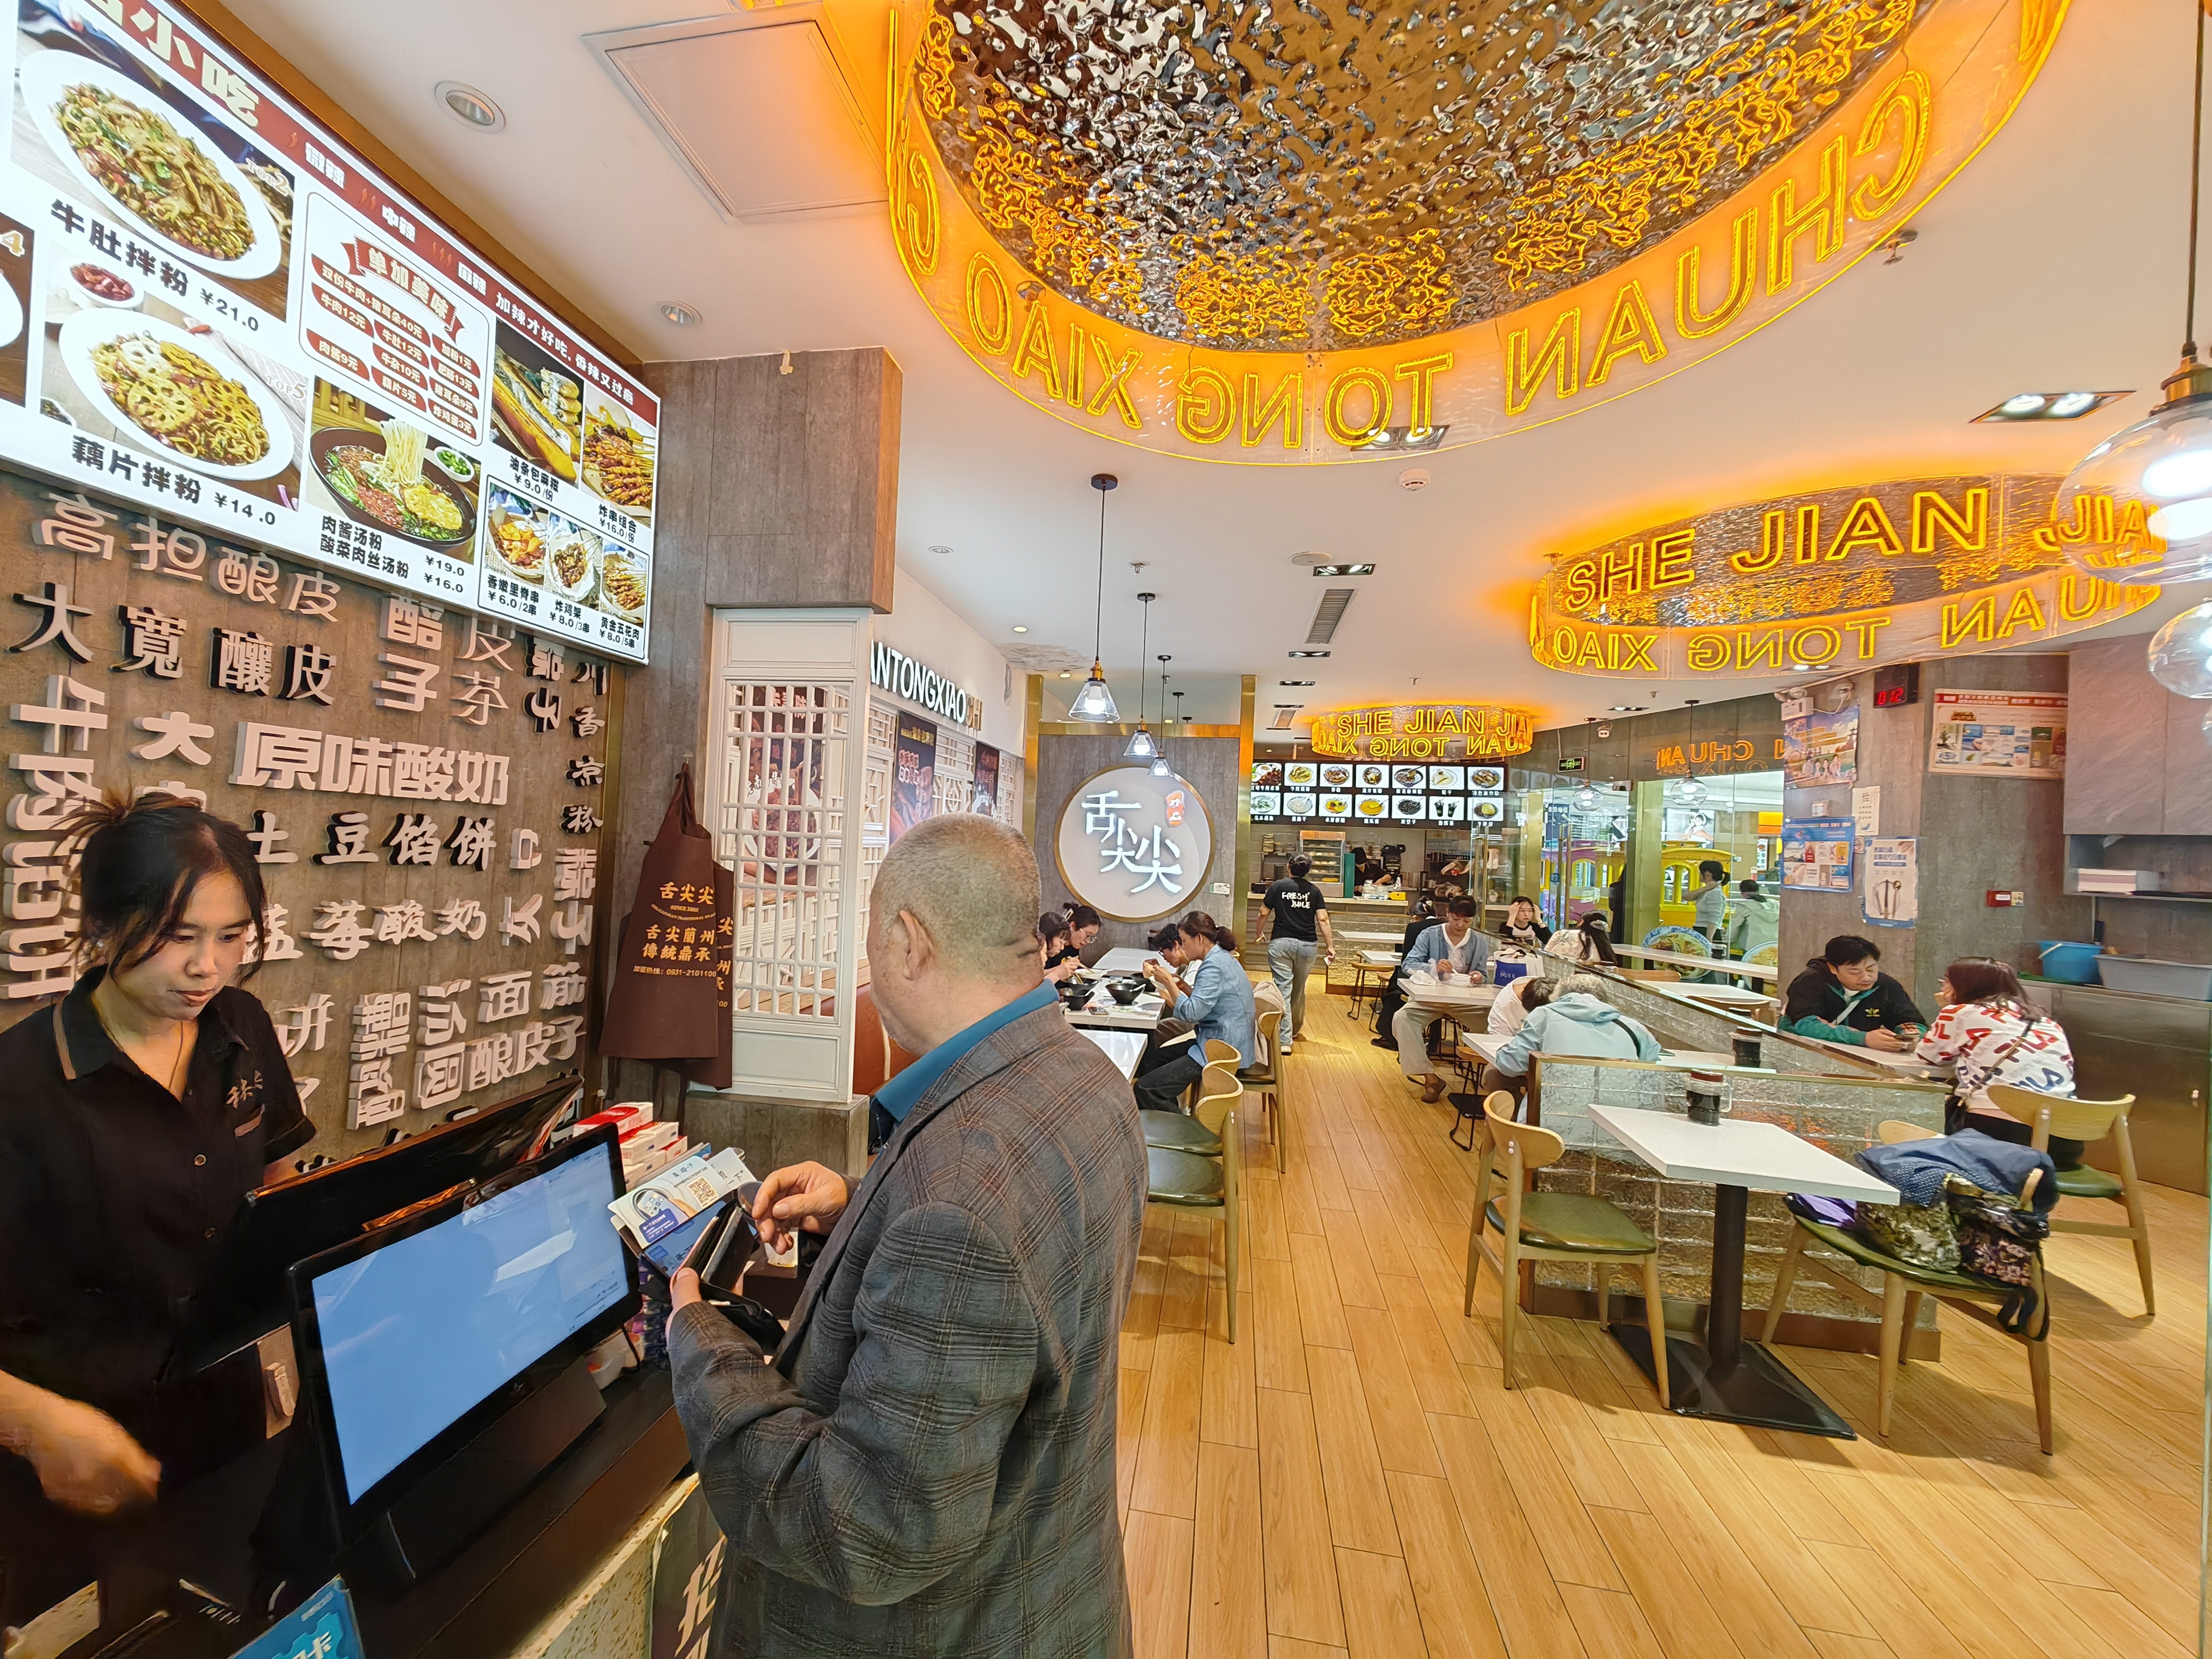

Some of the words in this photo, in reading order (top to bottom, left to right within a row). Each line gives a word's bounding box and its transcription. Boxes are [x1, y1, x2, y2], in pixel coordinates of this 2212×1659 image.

[51, 199, 188, 296] 牛肚拌粉
[368, 247, 449, 320] 单加美味
[321, 293, 366, 330] 牛肉12元
[319, 340, 358, 372] 肉酱9元
[382, 328, 422, 362] 牛肚12元
[381, 351, 420, 383] 牛杂10元
[433, 404, 472, 435] 炸鸡蛋3元
[72, 434, 202, 504] 藕片拌粉
[322, 515, 383, 551] 肉酱汤粉
[599, 503, 637, 534] 炸串组合
[320, 533, 409, 579] 酸菜肉丝汤粉
[1566, 528, 1695, 611] SHE
[1731, 488, 1988, 573] JIAN
[487, 574, 539, 604] 香嫩里脊串
[601, 616, 639, 640] 黄金五花肉
[1337, 711, 1393, 738] SHE
[1404, 709, 1485, 734] JIAN
[237, 722, 510, 805] 原味酸奶
[248, 812, 496, 871] 土豆馅饼
[1081, 791, 1183, 893] 舌尖尖
[659, 881, 715, 905] 舌尖尖
[1282, 892, 1308, 901] FRESH
[478, 962, 586, 1022] 面筋
[416, 979, 471, 1110] 汤圆
[463, 1016, 586, 1091] 酿皮子
